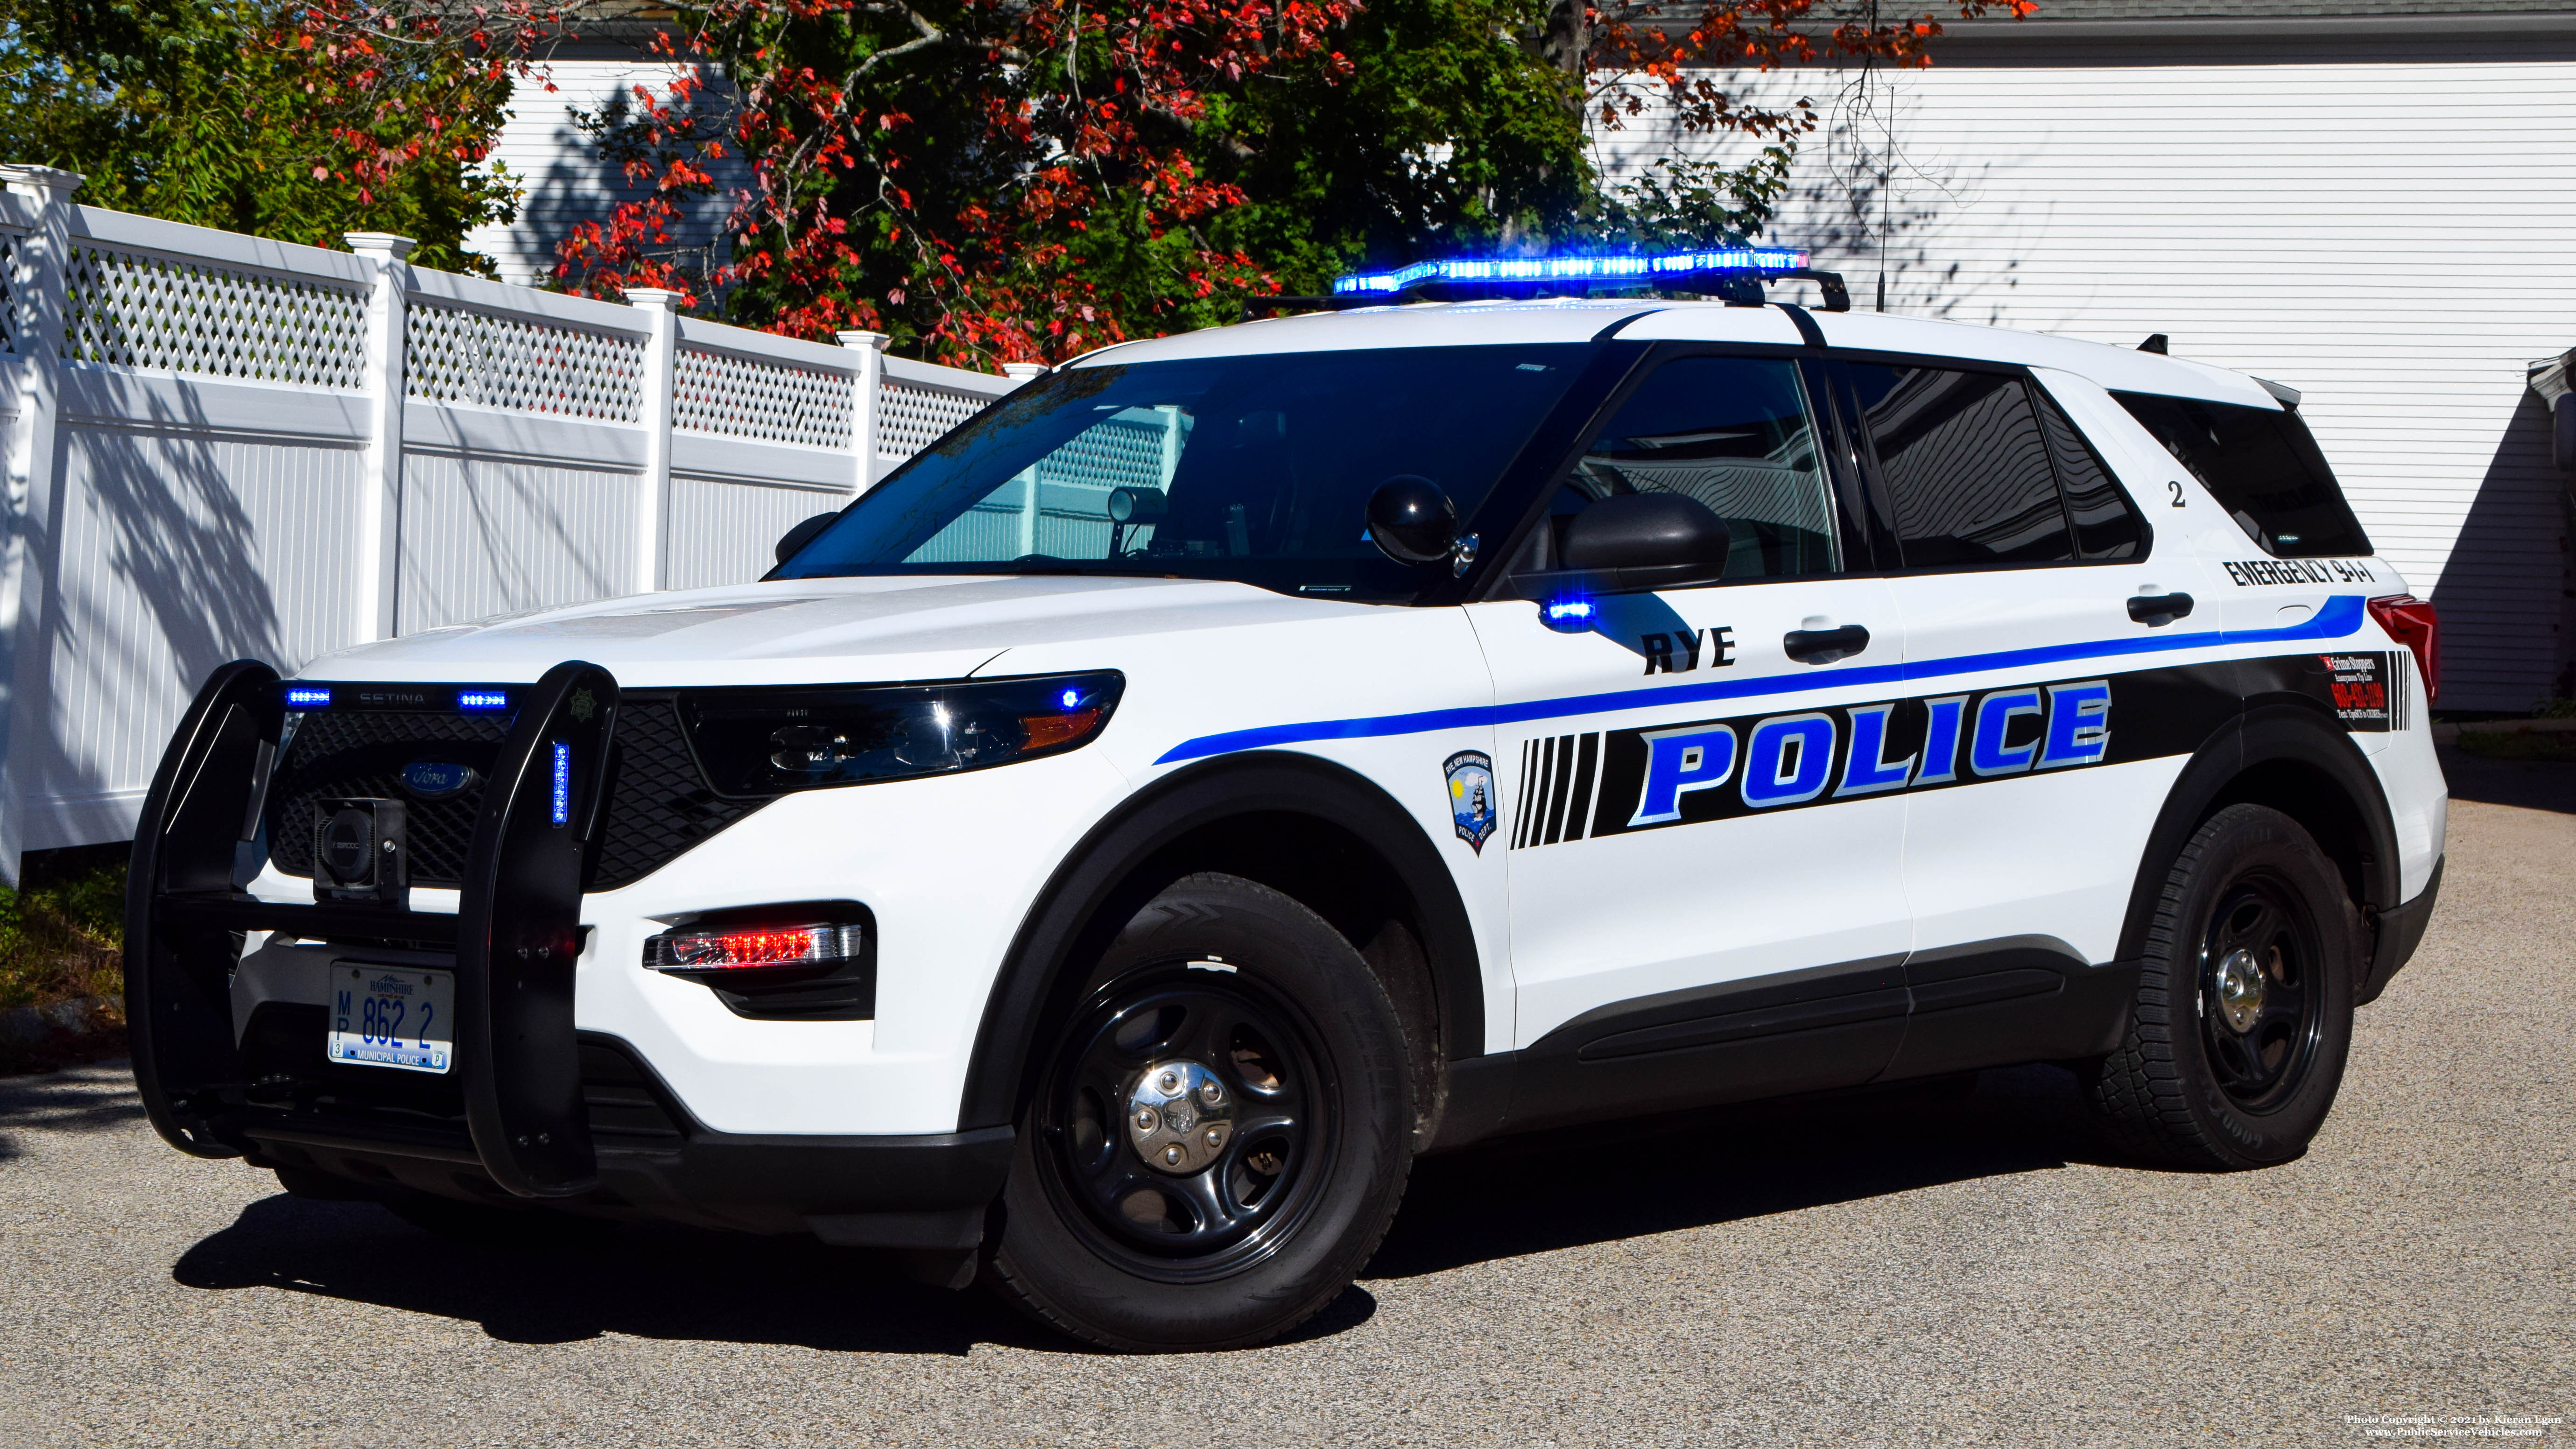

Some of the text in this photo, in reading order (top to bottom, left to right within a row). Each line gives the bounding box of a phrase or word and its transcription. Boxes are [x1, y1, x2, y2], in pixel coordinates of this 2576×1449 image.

[2168, 480, 2186, 507] 2
[2222, 559, 2376, 586] EMERGENCY 9-1-1
[1641, 626, 1736, 675] RYE
[2348, 656, 2375, 672] Stoppers
[360, 693, 425, 705] SETINA
[1453, 756, 1463, 767] NEW
[1463, 754, 1489, 767] HAMPSHIRE
[1627, 679, 2112, 827] POLICE
[1458, 826, 1475, 842] POLICE
[370, 980, 414, 995] HAMPSHIRE
[335, 1043, 340, 1054] 3
[357, 1049, 420, 1065] MUNICIPAL POLICE
